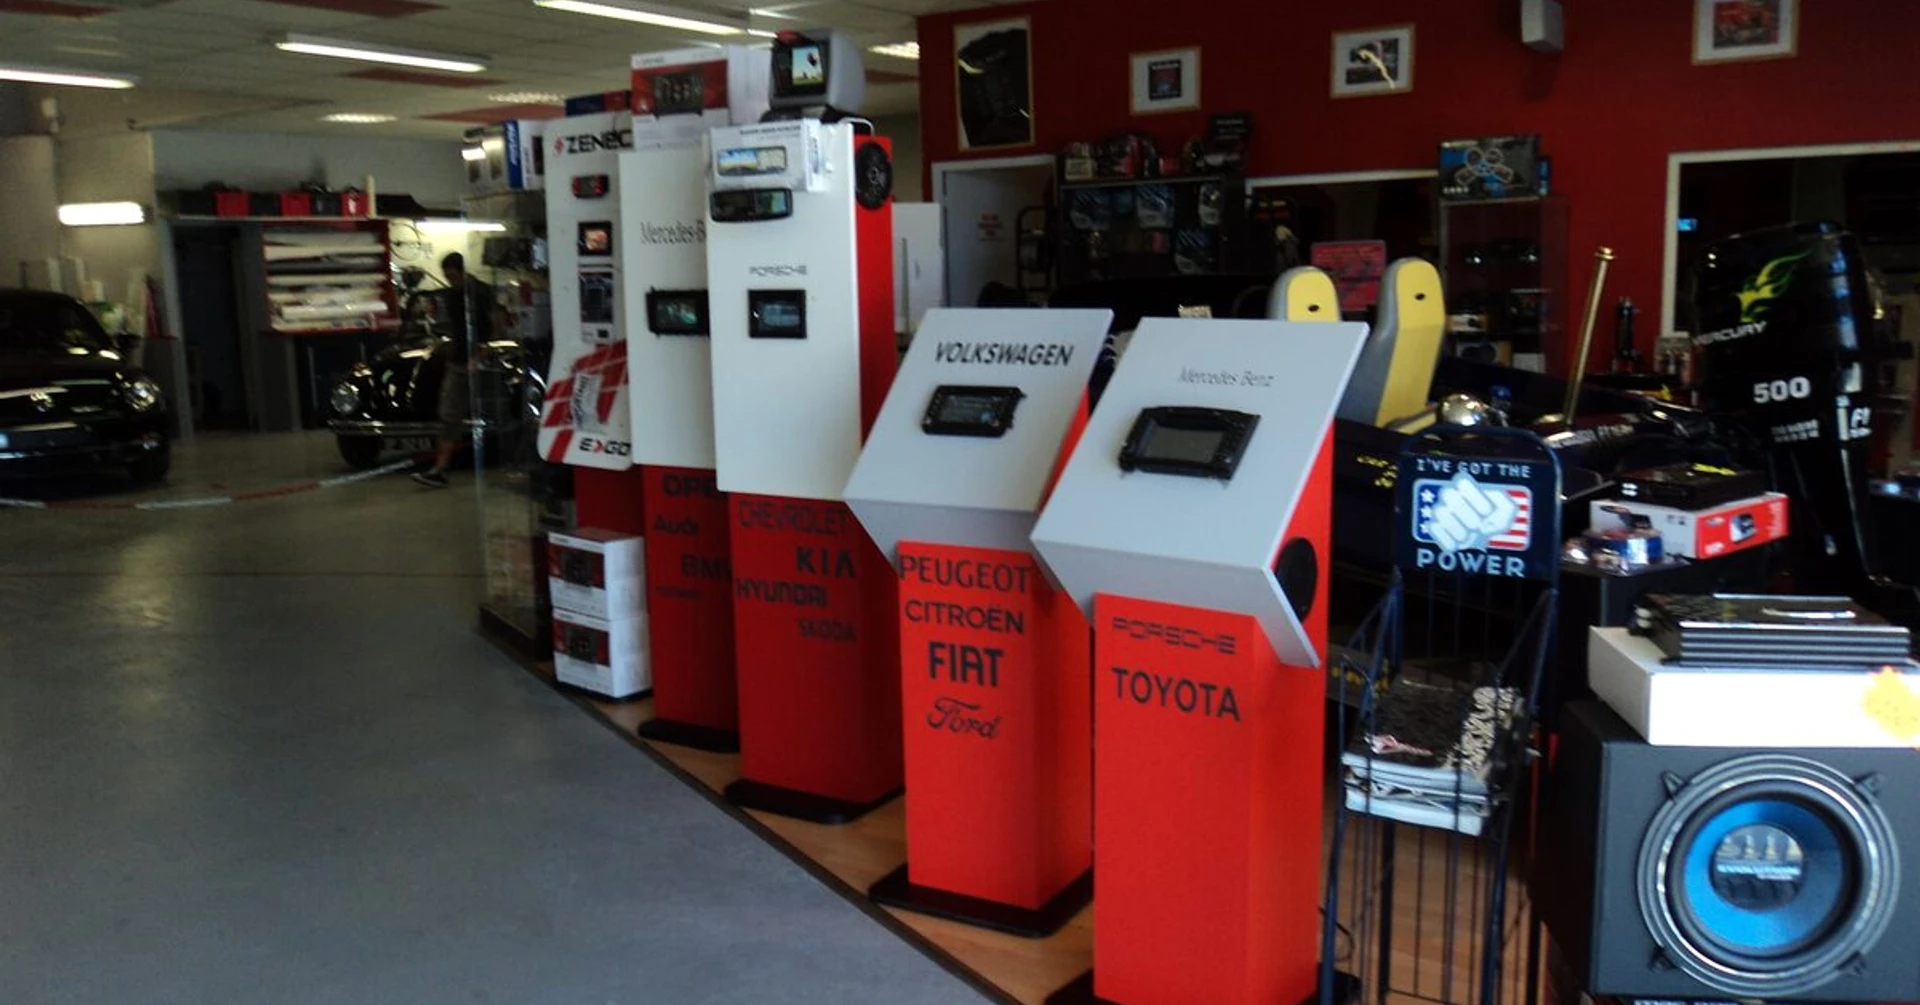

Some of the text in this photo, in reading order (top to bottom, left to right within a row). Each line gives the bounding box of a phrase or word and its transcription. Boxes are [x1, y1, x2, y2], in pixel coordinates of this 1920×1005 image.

[566, 129, 633, 154] ZENEC
[934, 340, 1075, 367] VOLKSWAGEN
[1753, 376, 1812, 404] 500
[1416, 458, 1533, 479] I'VE GOT THE
[738, 500, 847, 536] CHEVROLET
[796, 546, 857, 579] KIA
[899, 555, 1029, 593] PEUGEOT
[1416, 547, 1527, 579] POWER
[735, 577, 828, 609] HYUNDAI
[1112, 615, 1237, 656] PORSCHE
[928, 640, 1005, 688] FIAT
[1110, 666, 1242, 724] TOYOTA
[926, 696, 1003, 740] Ford
